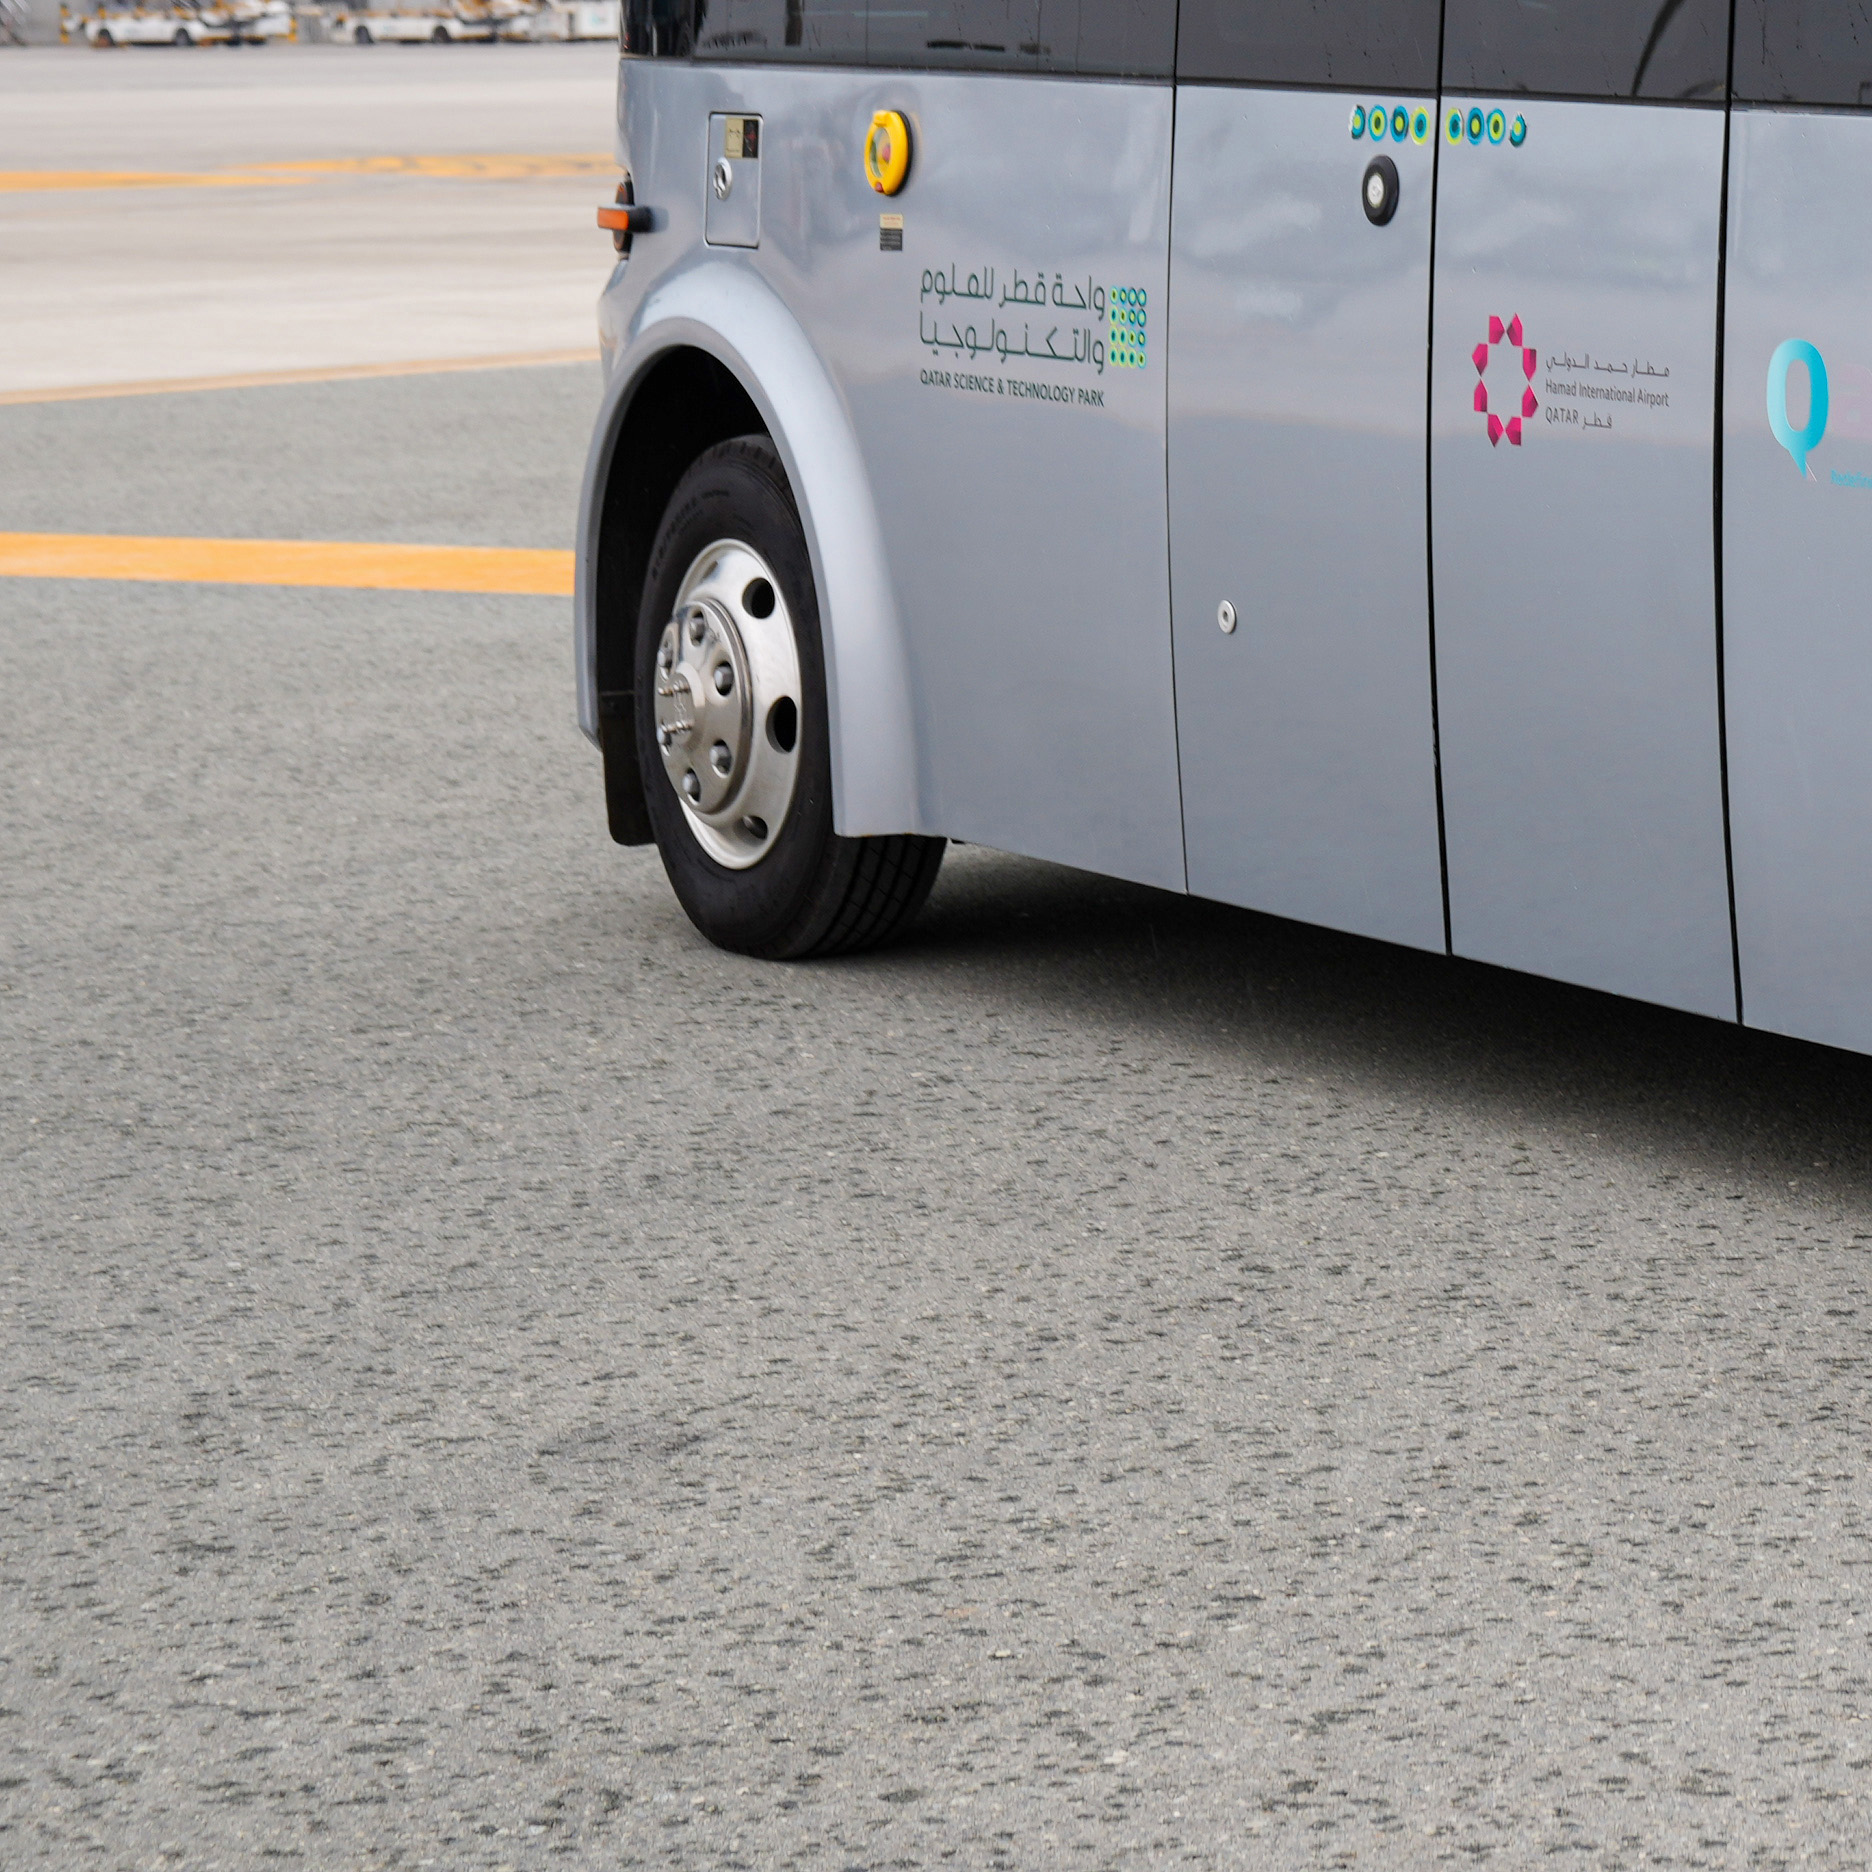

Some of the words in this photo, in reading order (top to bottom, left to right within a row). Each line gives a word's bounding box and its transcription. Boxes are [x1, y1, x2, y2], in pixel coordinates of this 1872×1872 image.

[920, 263, 994, 305] للعلوم
[999, 268, 1046, 308] قطر
[1052, 273, 1105, 321] واحة
[920, 310, 1105, 375] والتكنولوجيا
[1545, 351, 1590, 373] الدولي
[1593, 359, 1628, 374] حمد
[1630, 357, 1670, 378] مطار
[920, 368, 951, 388] QATAR
[954, 372, 995, 394] SCIENCE
[997, 379, 1004, 395] &
[1007, 380, 1075, 403] TECHNOLOGY
[1078, 388, 1105, 407] PARK
[1545, 378, 1577, 397] Hamad
[1579, 380, 1636, 403] International
[1637, 388, 1670, 408] Airport
[1545, 406, 1579, 425] QATAR
